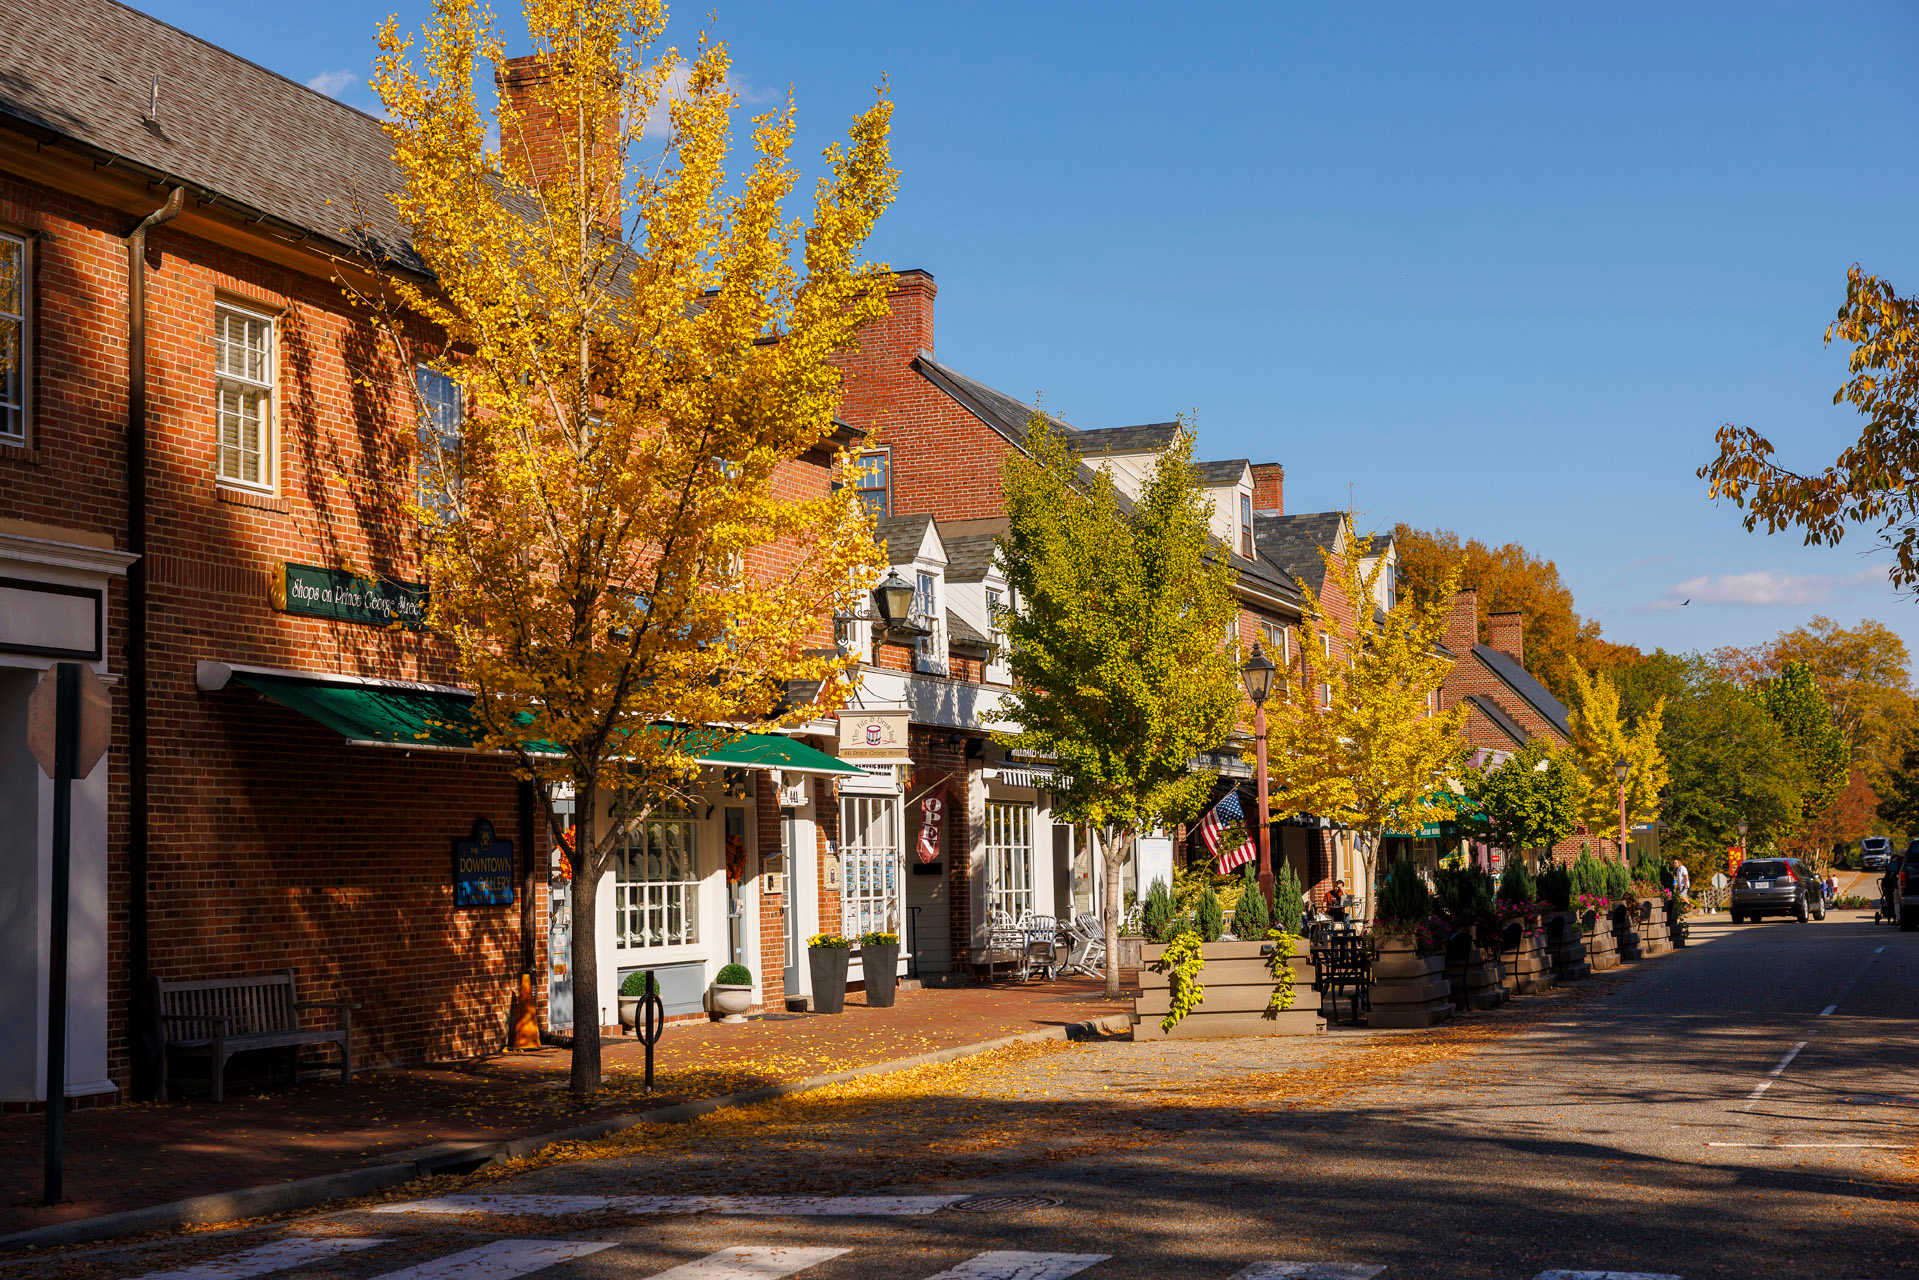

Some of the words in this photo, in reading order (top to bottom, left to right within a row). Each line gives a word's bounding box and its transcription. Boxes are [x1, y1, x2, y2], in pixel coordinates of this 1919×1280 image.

[292, 579, 320, 607] Shops
[322, 589, 332, 603] on
[335, 586, 362, 608] Prince
[364, 590, 394, 617] George
[919, 797, 942, 855] OPEN
[459, 857, 512, 873] DOWNTOWN
[477, 876, 511, 892] GALLERY
